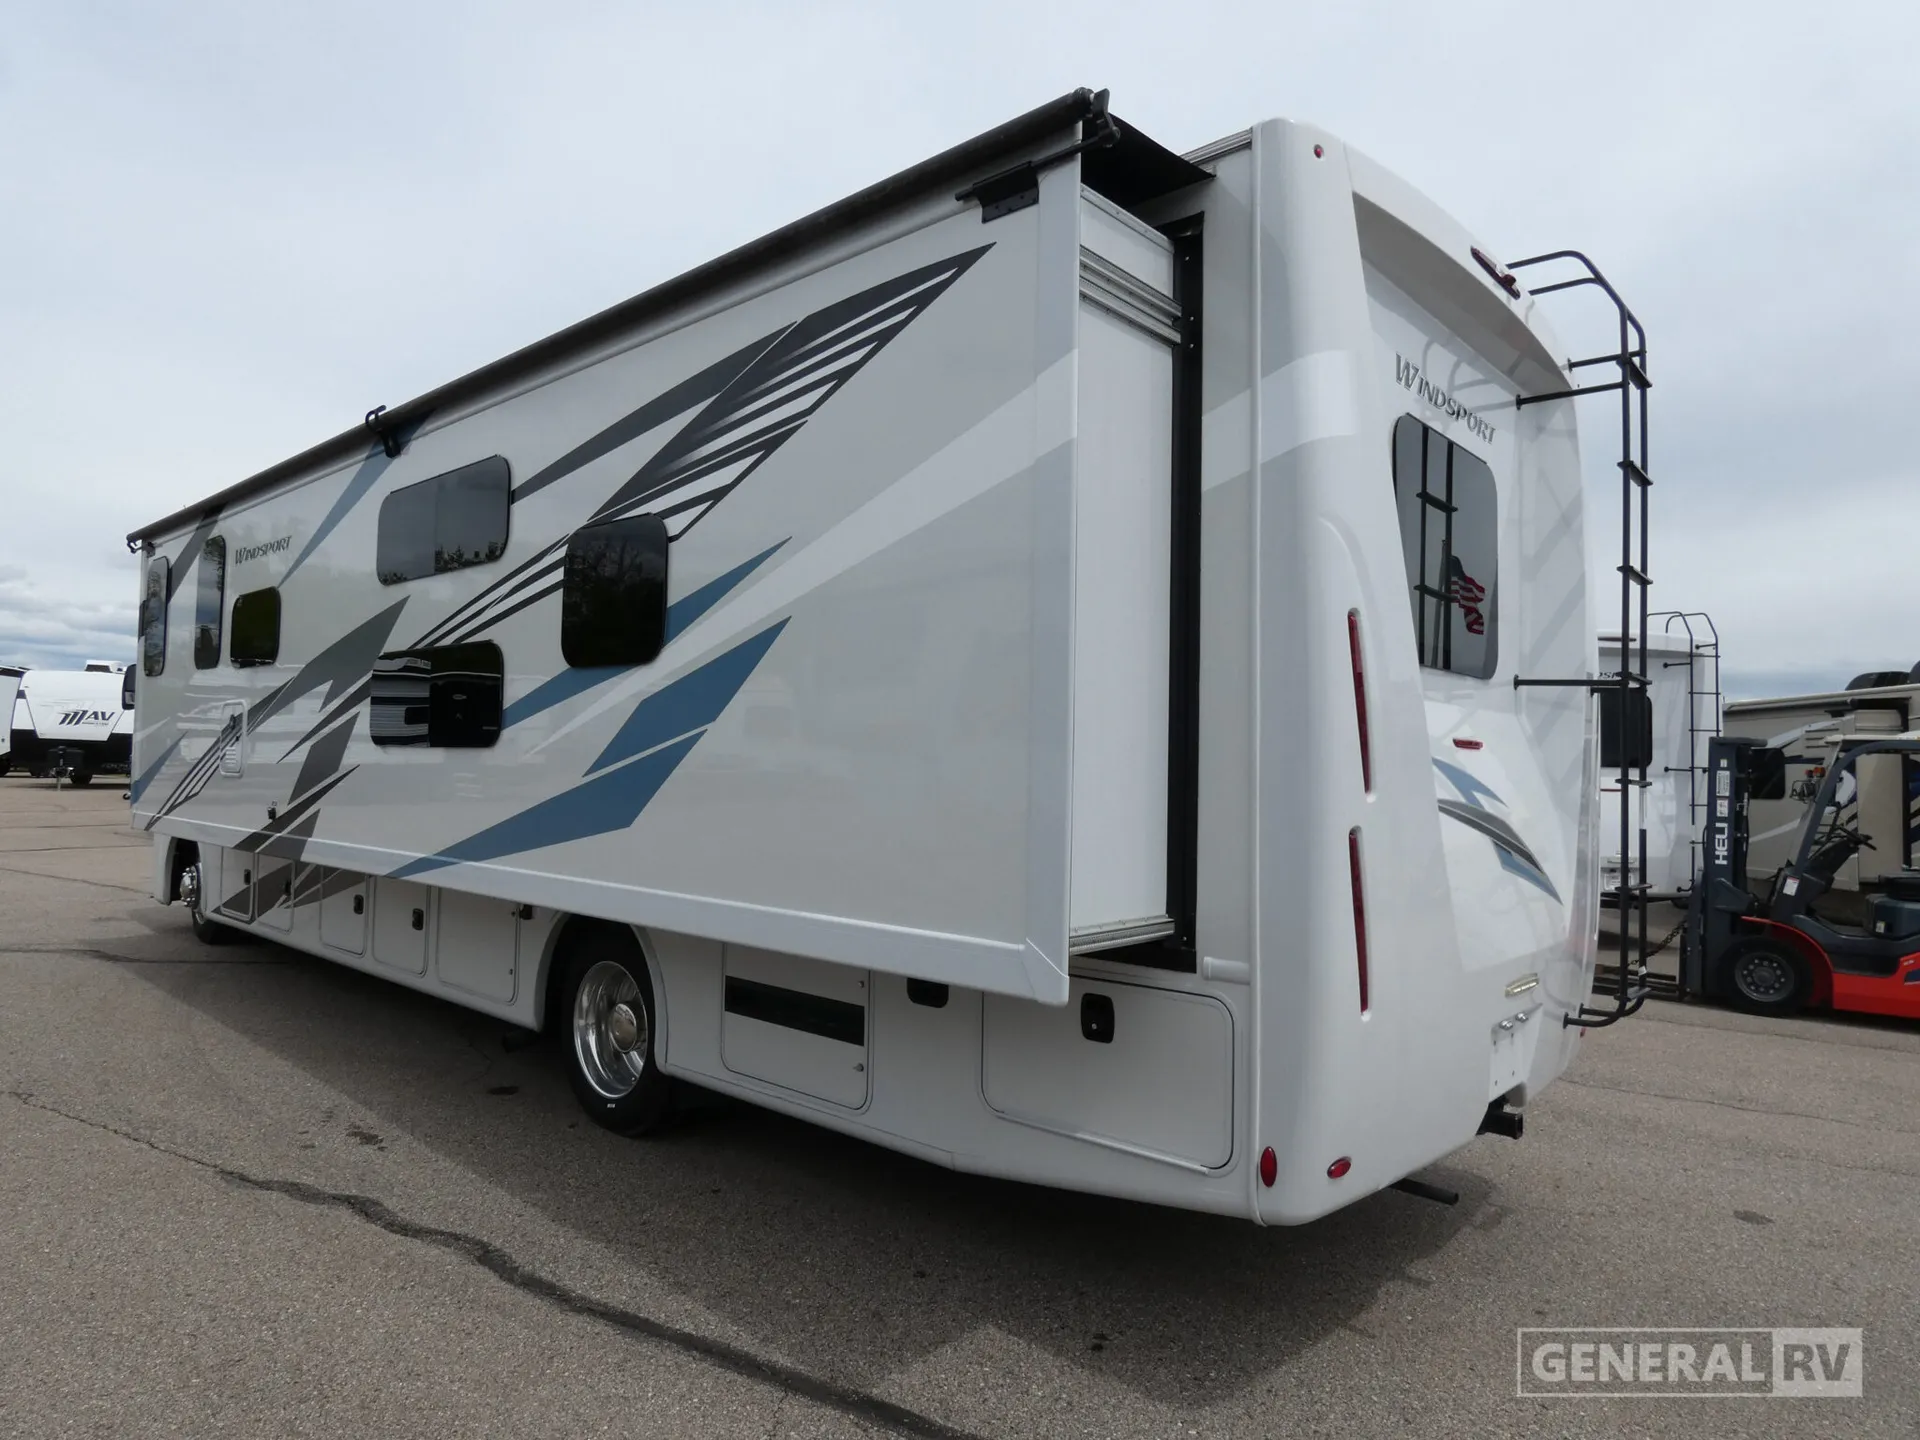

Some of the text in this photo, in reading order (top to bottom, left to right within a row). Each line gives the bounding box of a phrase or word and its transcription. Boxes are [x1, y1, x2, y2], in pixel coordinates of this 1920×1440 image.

[1395, 352, 1496, 444] WINDSPORT
[235, 535, 292, 565] WINDSPORT
[1714, 822, 1729, 866] HELI
